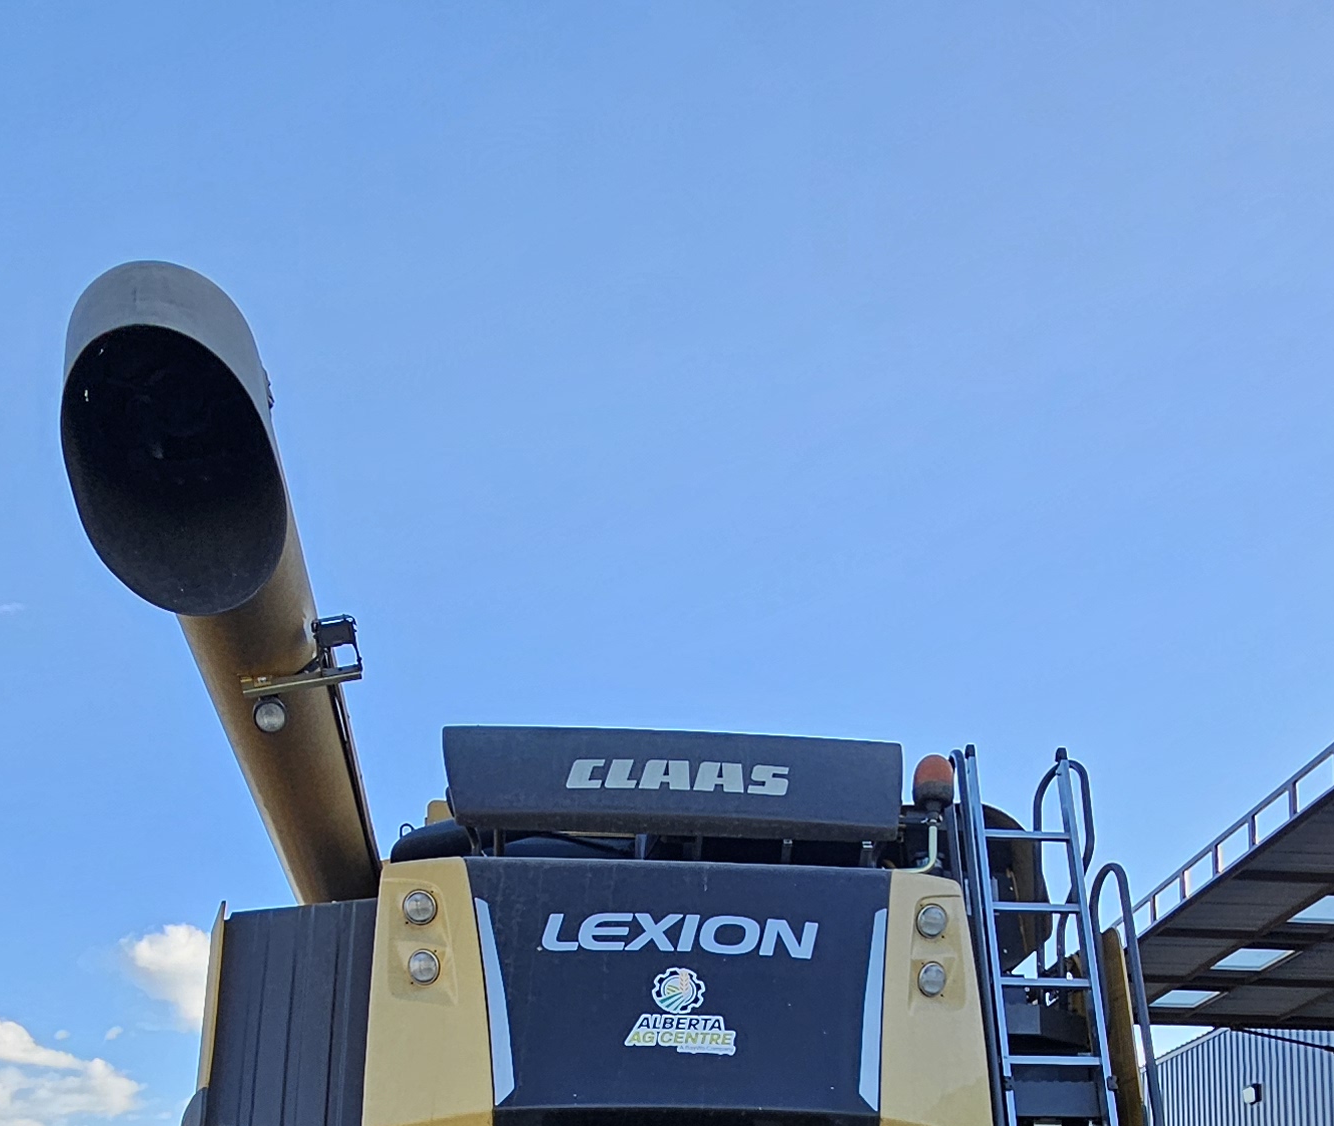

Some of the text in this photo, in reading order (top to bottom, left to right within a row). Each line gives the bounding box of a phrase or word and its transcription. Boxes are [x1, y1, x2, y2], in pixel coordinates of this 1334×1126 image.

[566, 758, 790, 796] CLAAS
[541, 912, 819, 960] LEXION
[637, 1017, 722, 1031] ALBERTA
[628, 1030, 734, 1046] AG CENTRE
